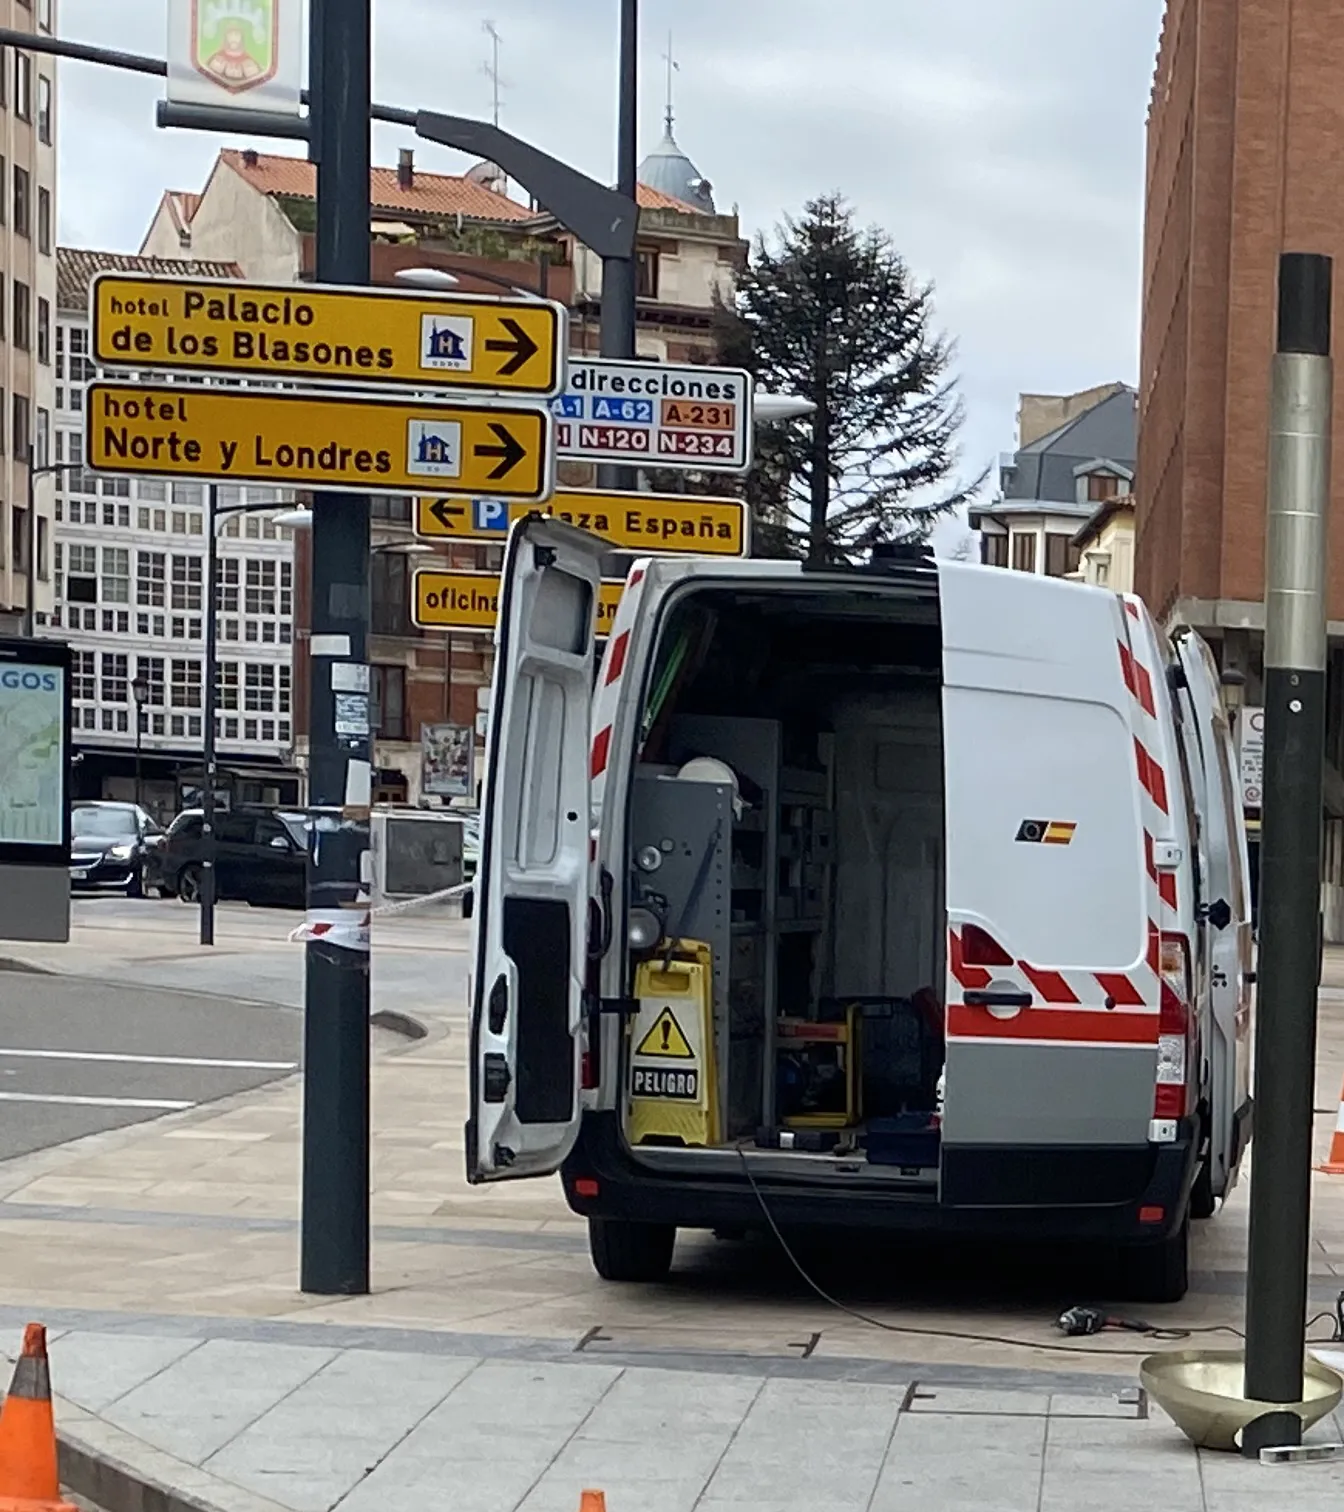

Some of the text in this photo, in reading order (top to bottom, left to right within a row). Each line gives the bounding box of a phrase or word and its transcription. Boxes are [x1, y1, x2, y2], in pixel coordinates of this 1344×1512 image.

[110, 291, 314, 326] hotel Palacio
[111, 325, 394, 369] de los Blasones
[571, 369, 736, 399] direcciones
[104, 393, 187, 422] hotel
[550, 398, 731, 426] A-1 A-62 A-231
[104, 426, 391, 474] Norte y Londres
[582, 427, 646, 449] N-120
[660, 432, 732, 455] N-234
[479, 500, 732, 540] P aza España
[1, 670, 56, 692] GOS
[634, 1070, 696, 1095] PELIGRO
